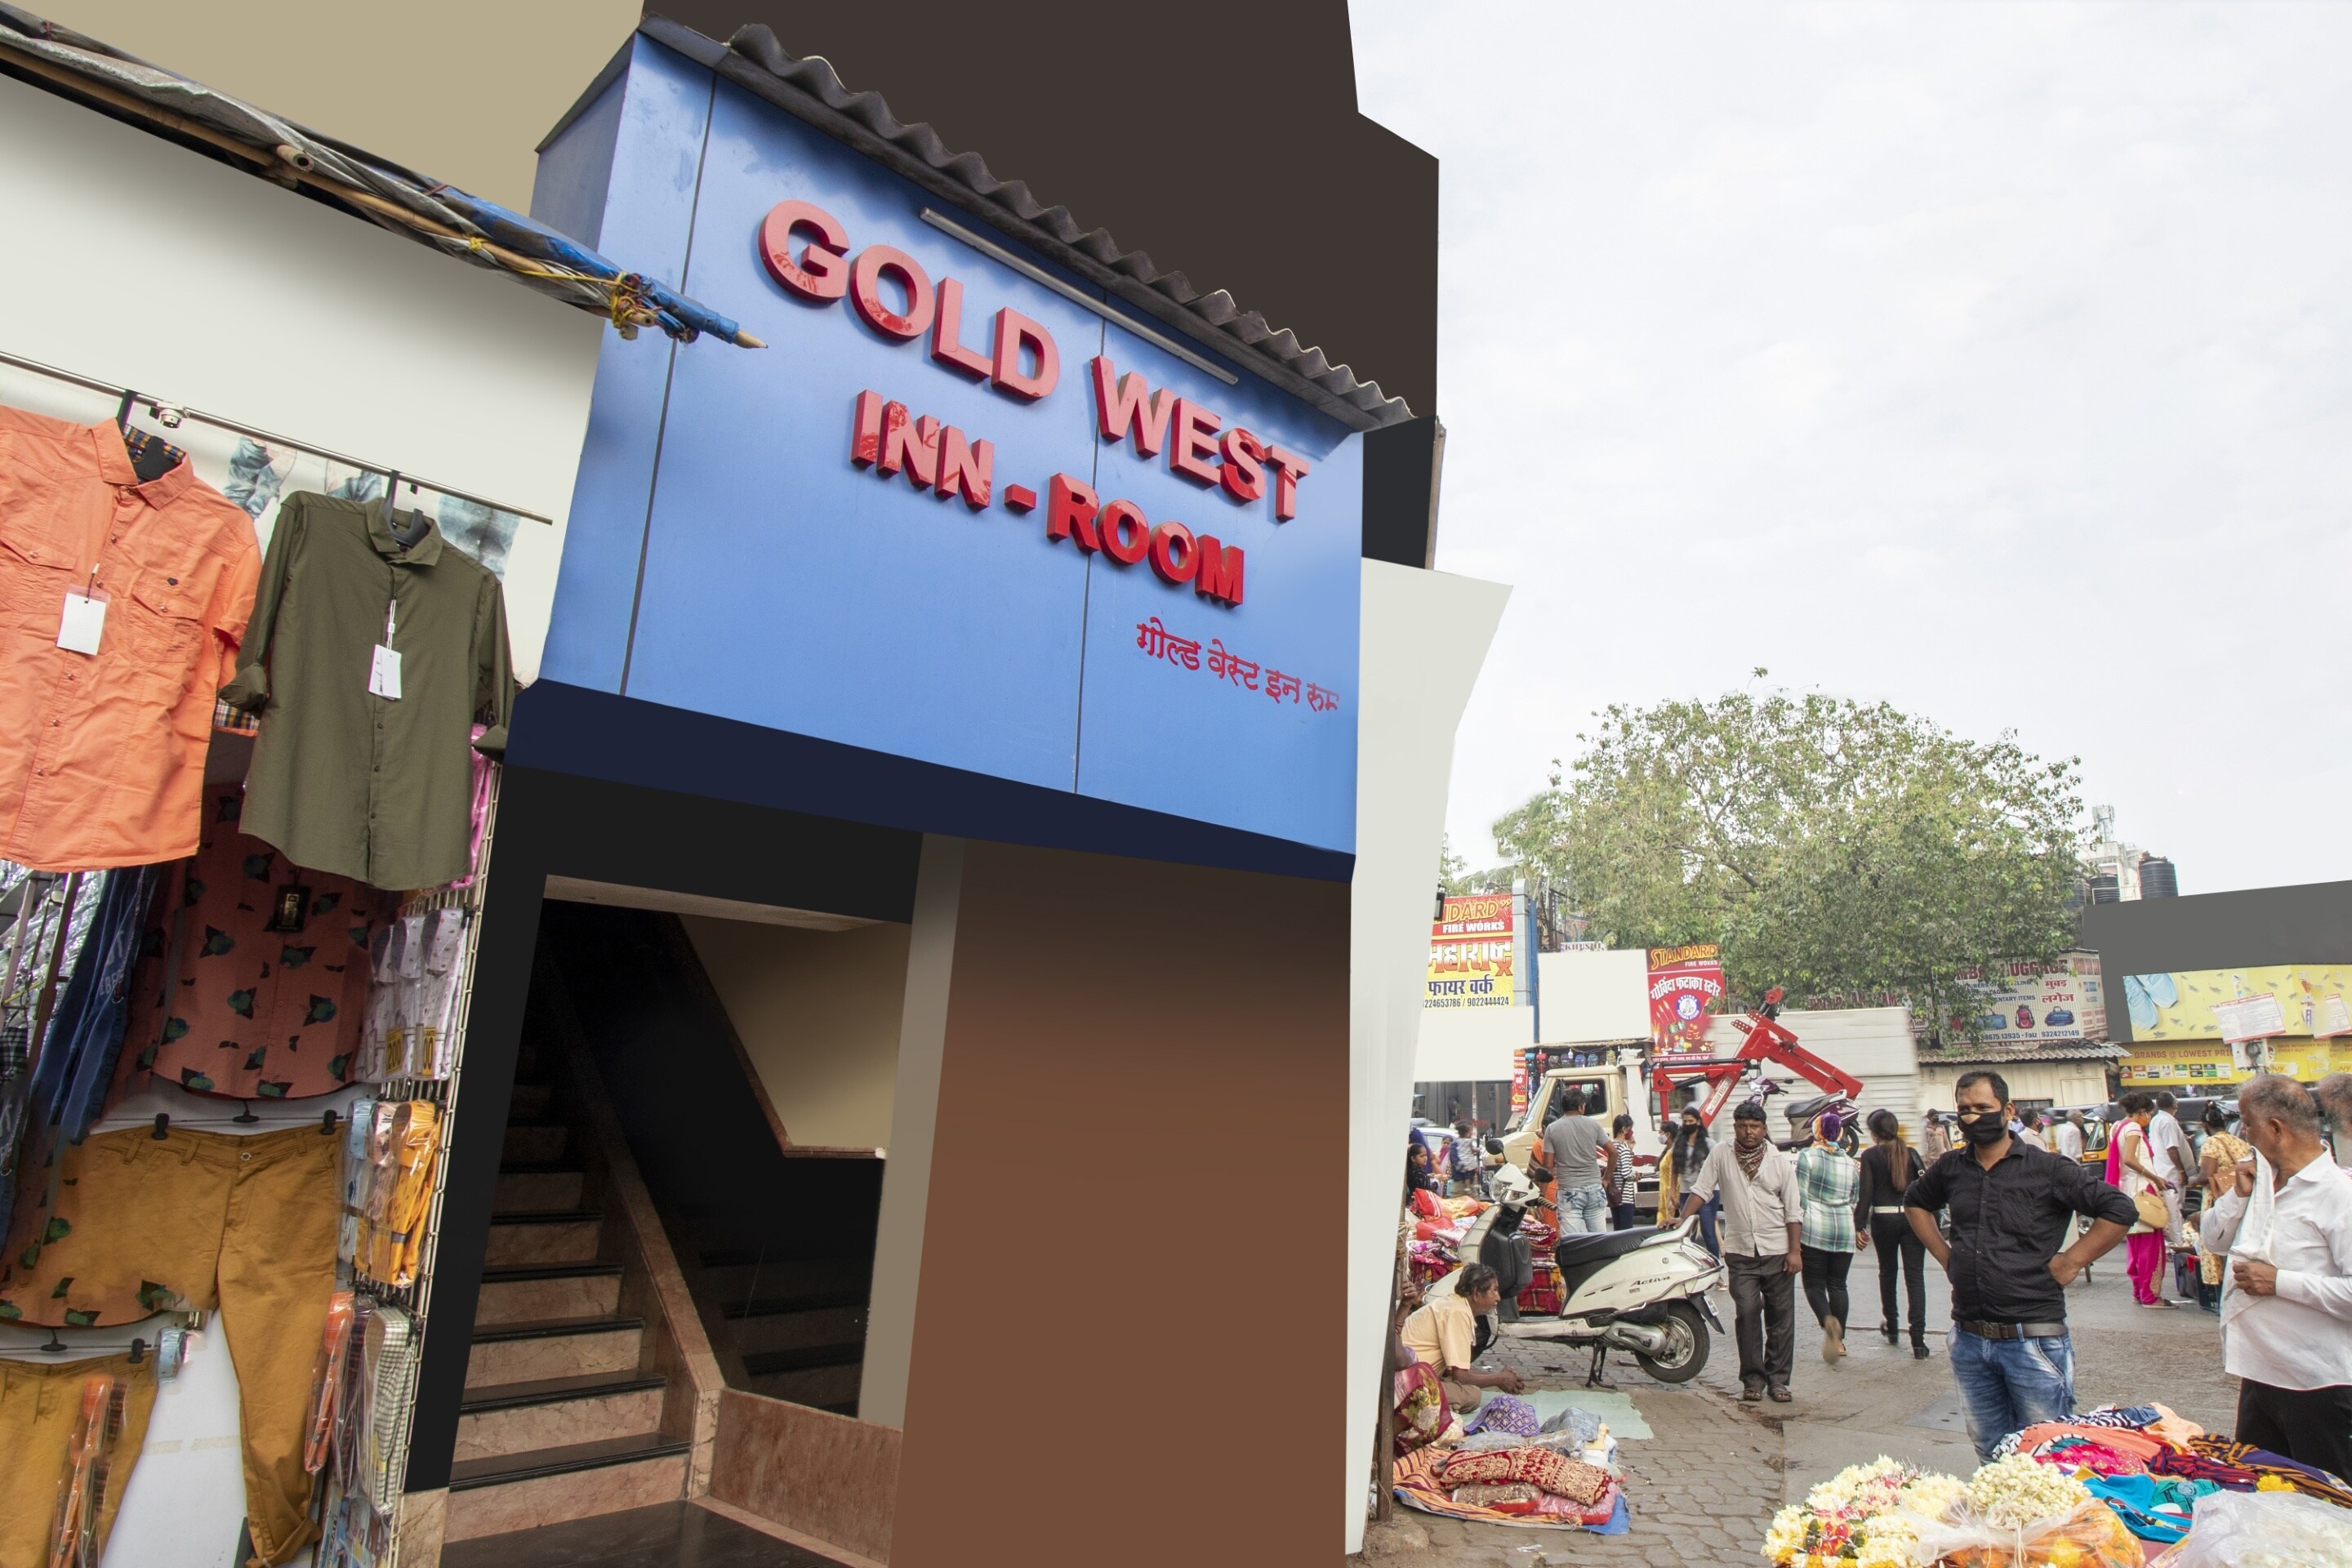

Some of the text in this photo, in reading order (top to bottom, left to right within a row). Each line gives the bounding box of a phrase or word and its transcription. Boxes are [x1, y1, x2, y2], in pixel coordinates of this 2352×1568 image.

[758, 199, 1310, 523] GOLD WEST
[1136, 616, 1202, 671] गोल्ड
[1206, 638, 1260, 691] वेस्ट
[1265, 667, 1302, 704] इन
[1442, 920, 1505, 933] FIRE WORKS
[1650, 944, 1718, 971] STANDARD
[1428, 973, 1494, 996] फायर वर्क
[1650, 976, 1676, 1000] गोविंदा
[1423, 998, 1461, 1009] 224653786
[1467, 996, 1509, 1007] 9022444424
[2042, 991, 2074, 1004] लगेज
[2042, 1029, 2079, 1038] 9324212149
[423, 1036, 434, 1071] 00
[2134, 1051, 2167, 1059] BRANDS
[2178, 1049, 2212, 1058] LOWEST
[1630, 1276, 1672, 1287] Activa
